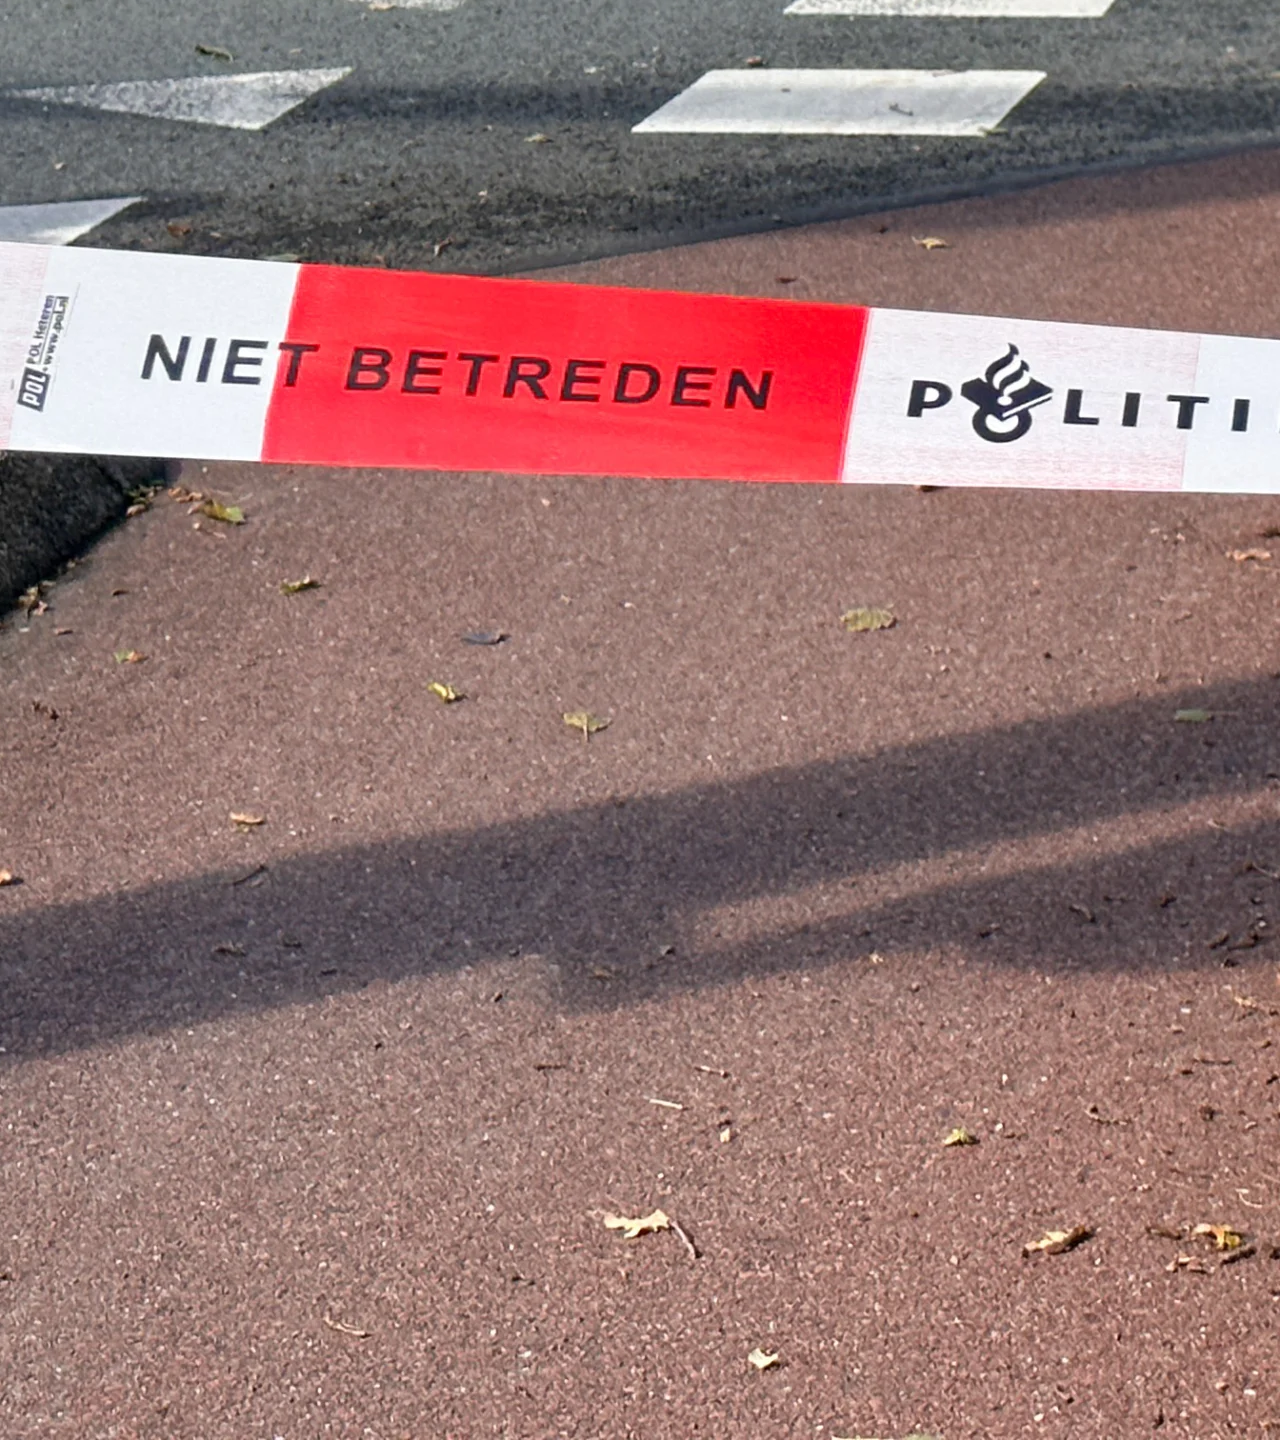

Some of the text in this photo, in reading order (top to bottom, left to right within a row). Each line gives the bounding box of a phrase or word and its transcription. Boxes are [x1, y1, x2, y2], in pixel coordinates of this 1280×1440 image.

[20, 370, 49, 409] POL
[141, 334, 774, 411] NIET BETREDEN
